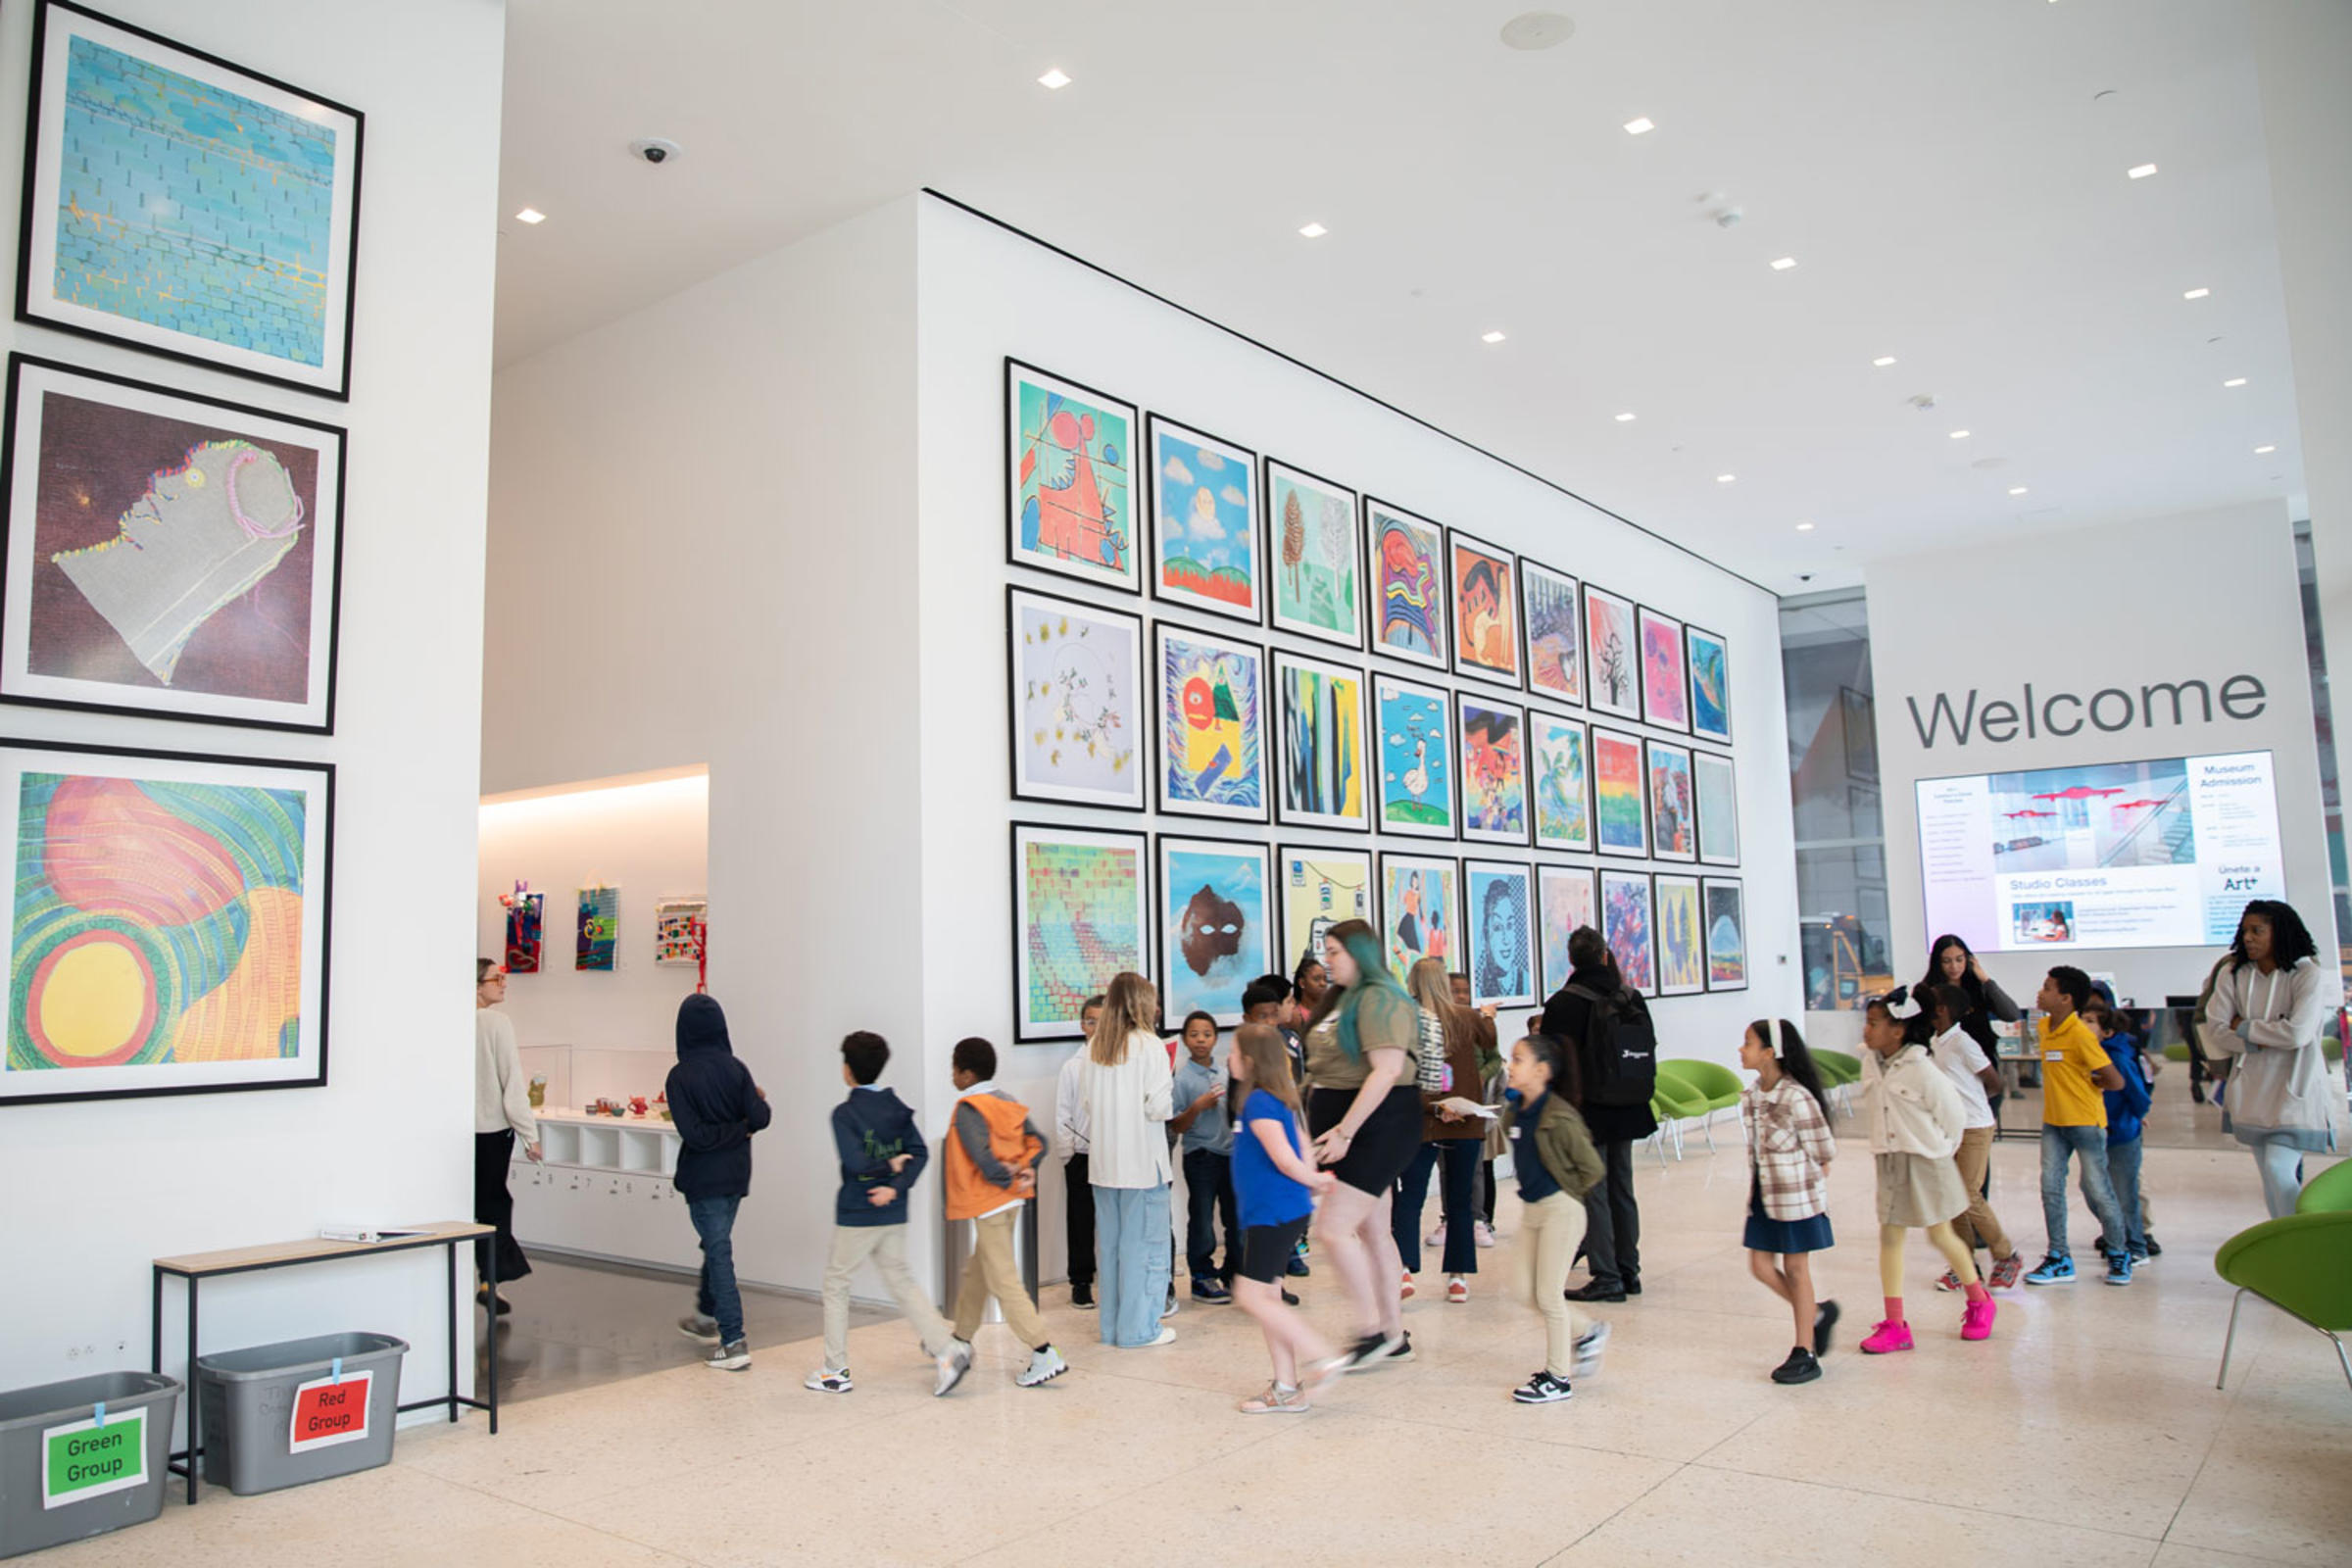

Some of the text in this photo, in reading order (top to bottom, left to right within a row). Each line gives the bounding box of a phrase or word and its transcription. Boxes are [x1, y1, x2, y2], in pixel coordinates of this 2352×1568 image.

[1906, 674, 2267, 749] Welcome
[2204, 763, 2255, 774] Museum
[2200, 776, 2262, 788] Admission
[2010, 876, 2108, 891] Studio Classes
[318, 1390, 346, 1407] Red
[308, 1412, 351, 1433] Group
[68, 1433, 122, 1456] Green
[68, 1457, 123, 1482] Group
